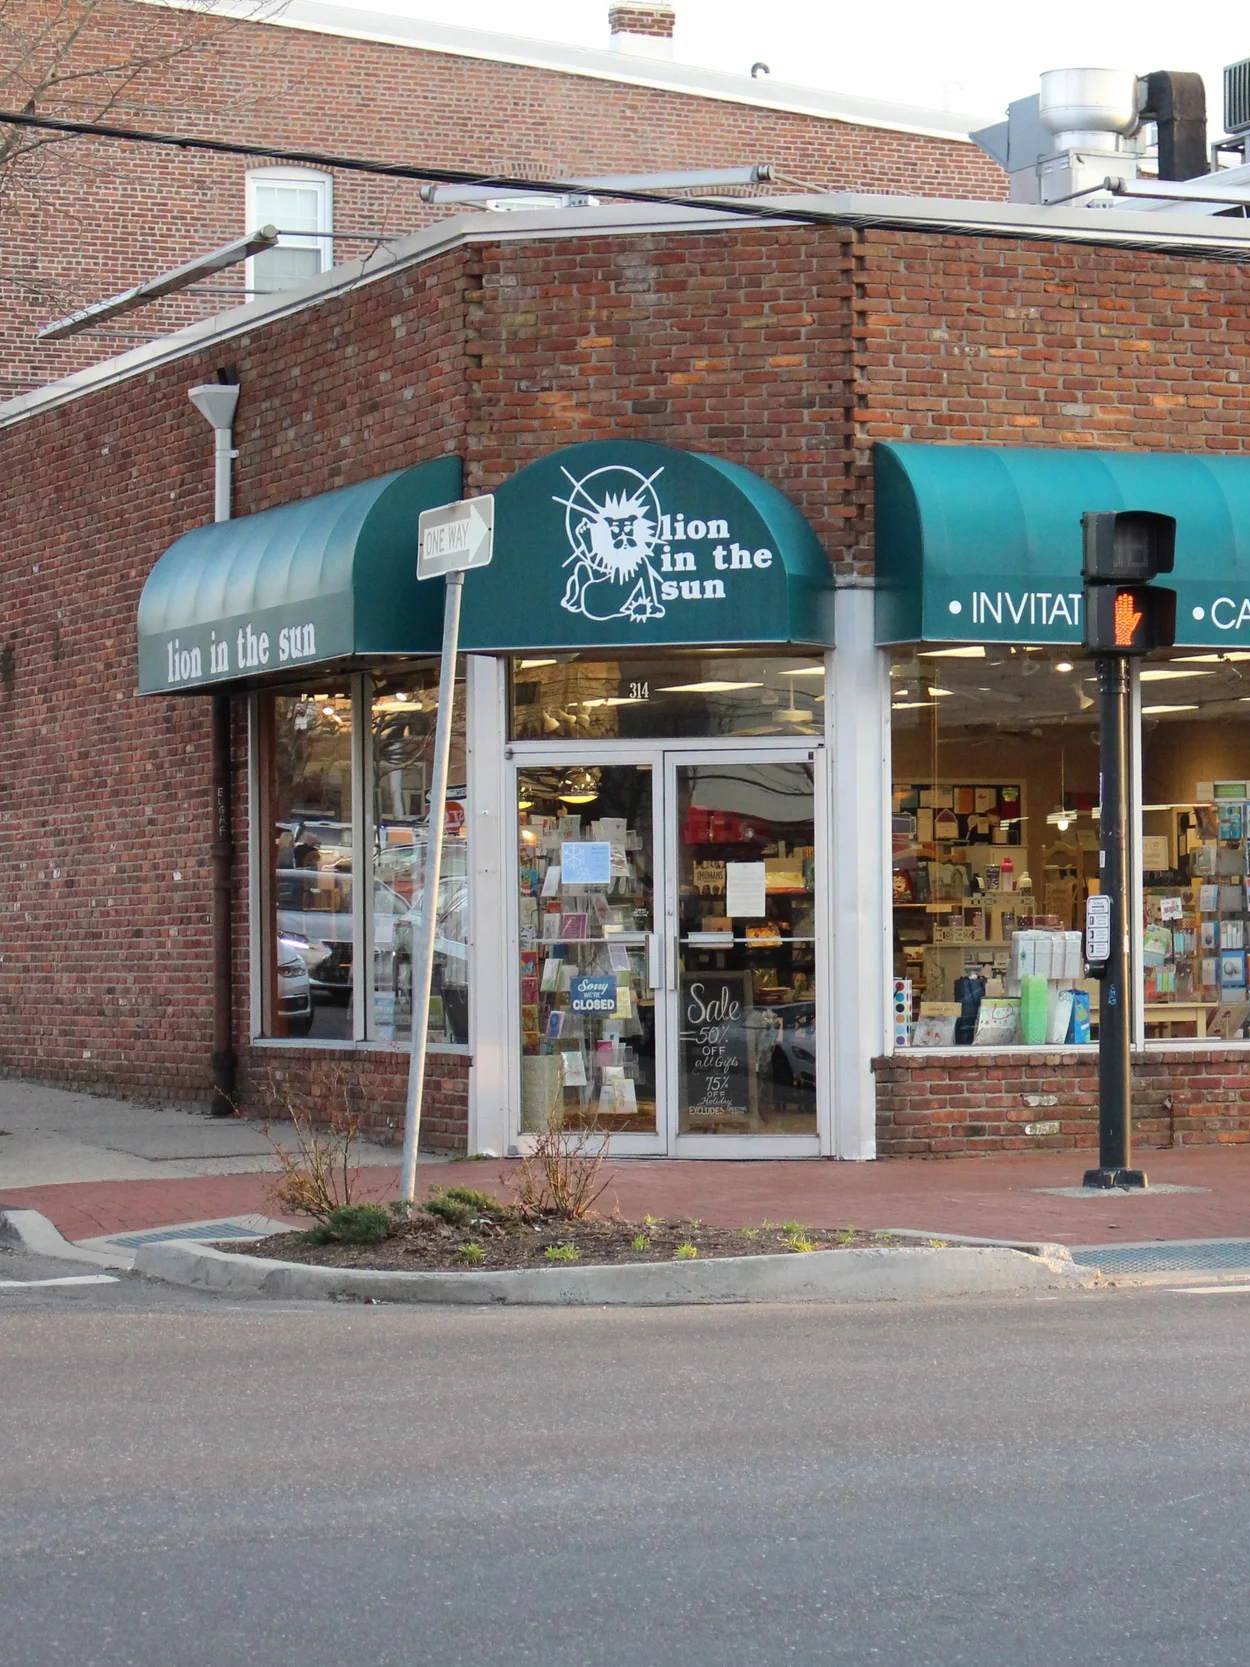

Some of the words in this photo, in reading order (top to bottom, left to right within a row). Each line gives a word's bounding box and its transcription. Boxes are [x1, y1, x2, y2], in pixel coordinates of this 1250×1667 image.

[660, 509, 730, 541] lion
[425, 528, 445, 556] ONE
[448, 521, 470, 550] WAY
[660, 541, 697, 572] in
[712, 542, 773, 571] the
[660, 576, 727, 601] sun
[972, 591, 1083, 626] INVITAT
[167, 638, 203, 683] lion
[209, 630, 229, 674] in
[236, 623, 270, 669] the
[278, 622, 316, 662] sun
[629, 681, 650, 699] 314
[577, 978, 609, 995] Sorry
[572, 999, 616, 1011] CLOSED
[687, 982, 742, 1024] Sale
[695, 1025, 730, 1044] 50%
[702, 1046, 726, 1056] OFF
[705, 1076, 730, 1091] 75%
